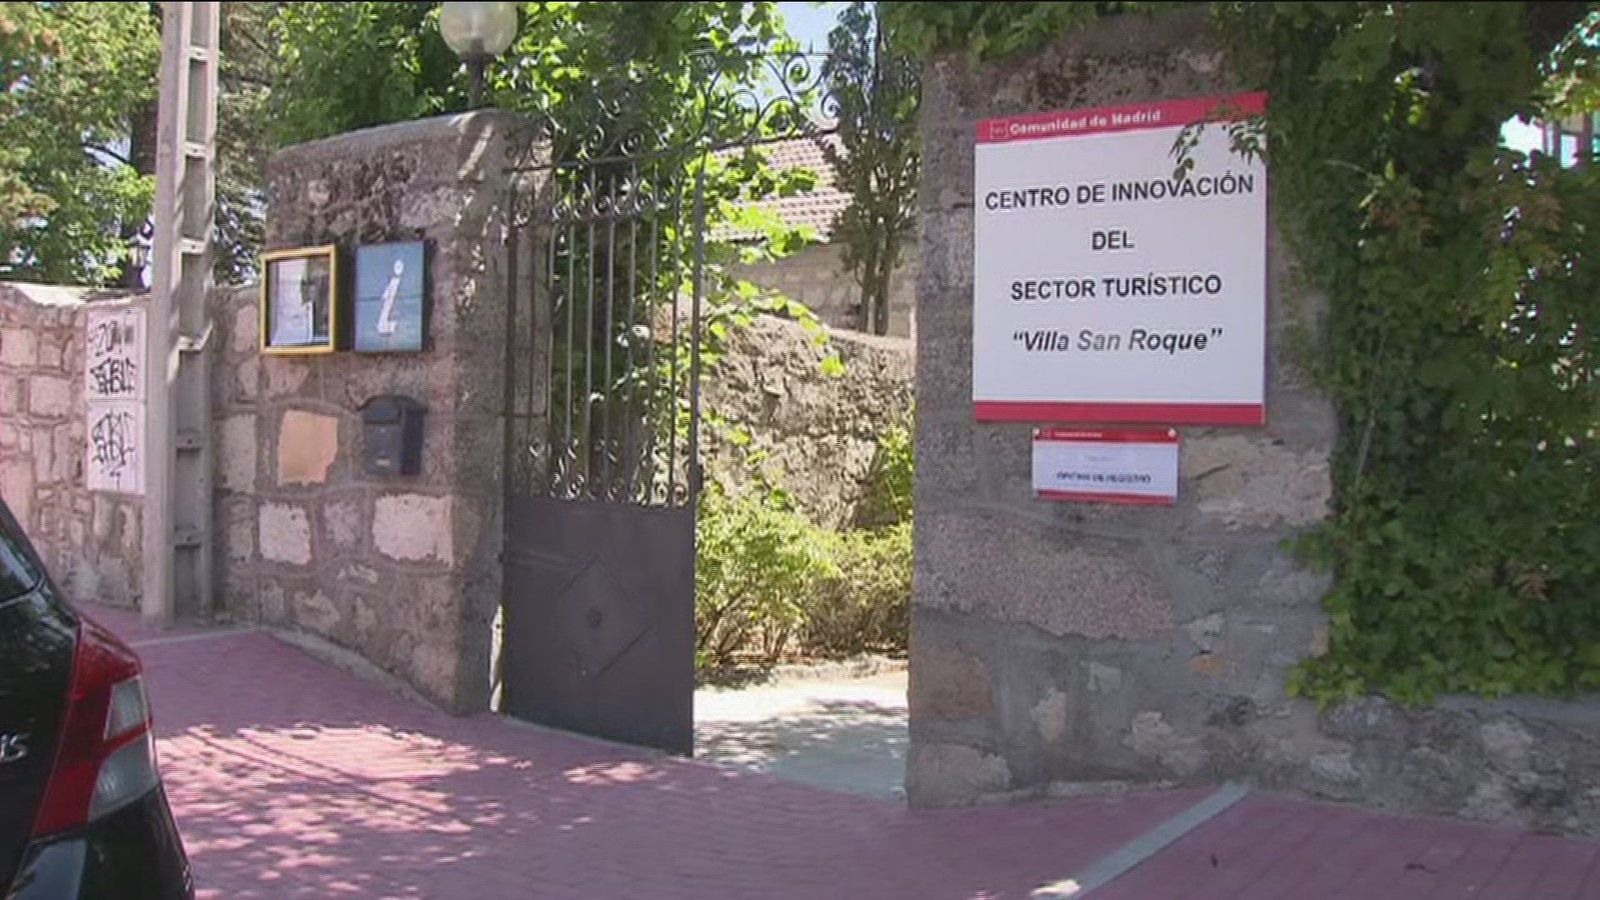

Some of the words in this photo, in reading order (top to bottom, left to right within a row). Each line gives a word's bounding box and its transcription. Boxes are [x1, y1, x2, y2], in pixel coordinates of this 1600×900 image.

[1010, 117, 1087, 135] Comunidad
[1089, 115, 1107, 128] de
[1112, 110, 1161, 125] Madrid
[985, 187, 1070, 210] CENTRO
[1077, 185, 1105, 204] DE
[1112, 171, 1253, 201] INNOVACIÓN
[1092, 231, 1134, 250] DEL
[1011, 280, 1096, 301] SECTOR
[1102, 273, 1222, 297] TURÍSTICO
[1077, 331, 1120, 350] San
